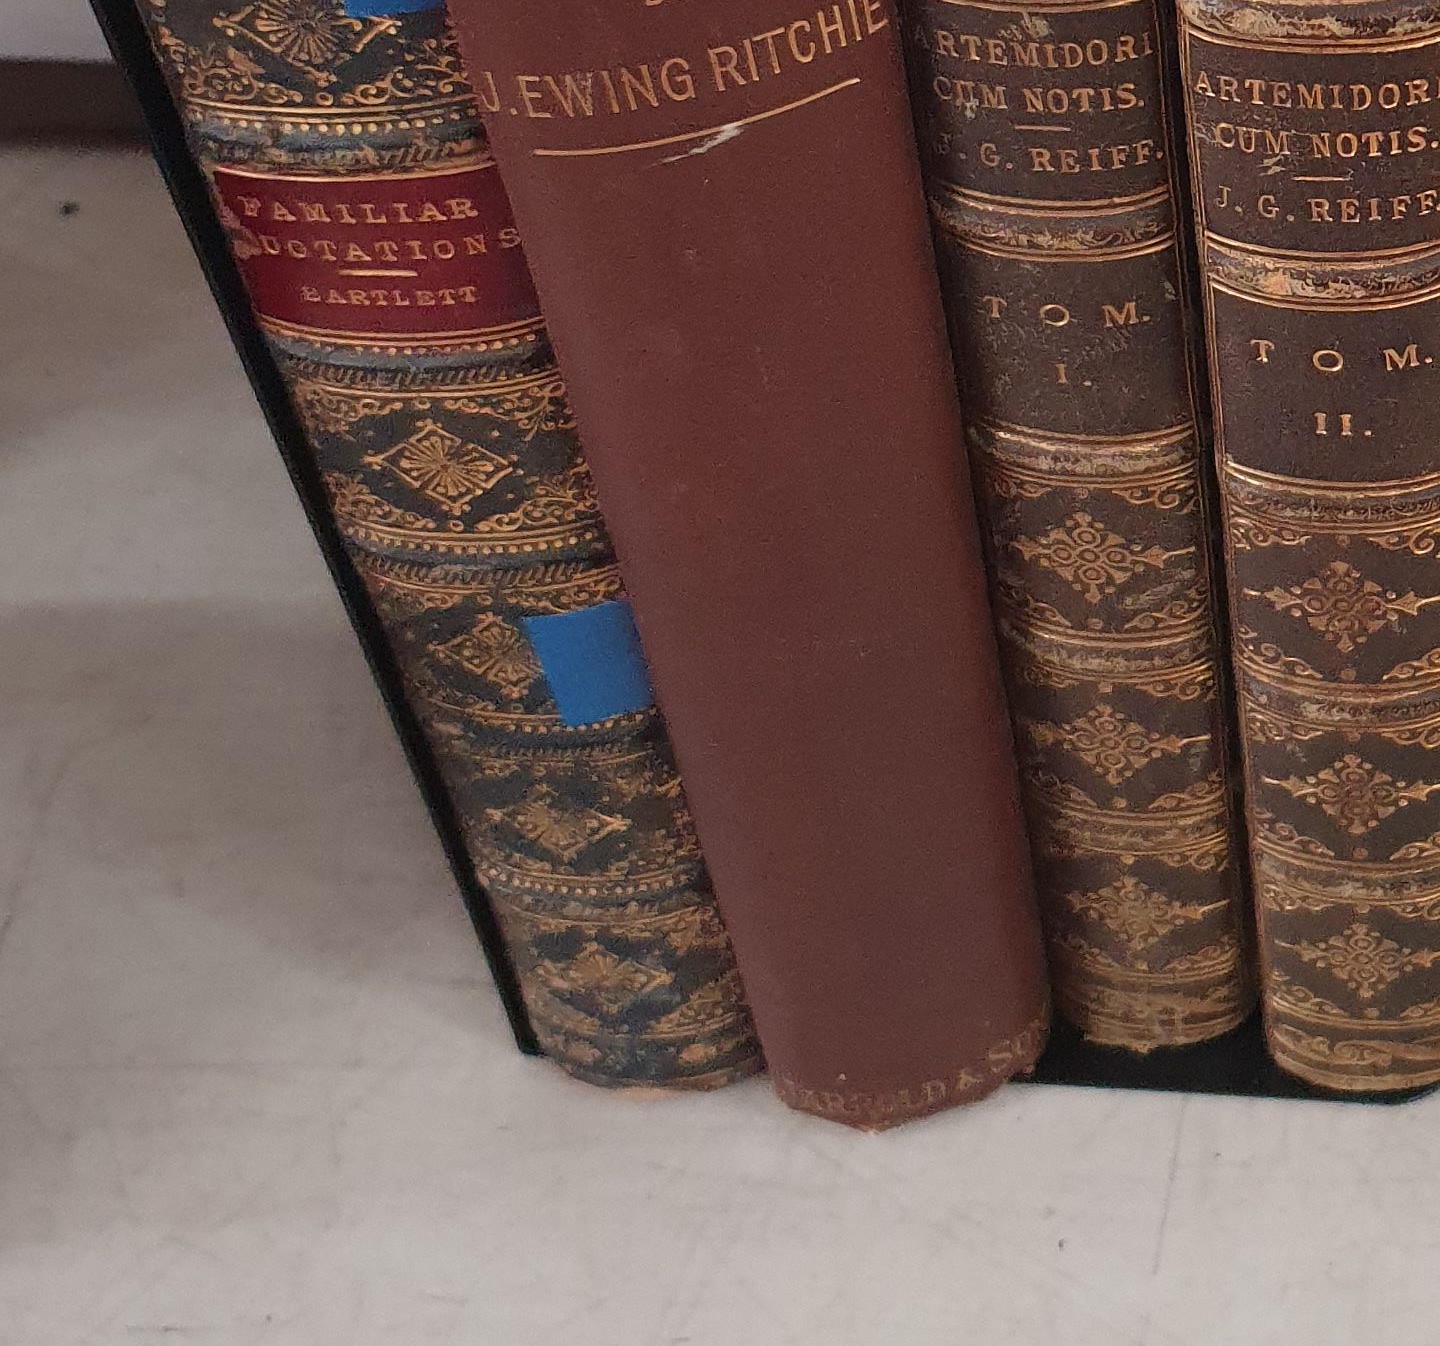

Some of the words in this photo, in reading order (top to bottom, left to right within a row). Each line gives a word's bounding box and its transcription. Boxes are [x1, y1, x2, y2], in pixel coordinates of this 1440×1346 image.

[1023, 82, 1146, 114] NOTIS.
[979, 142, 1014, 170] G.
[1029, 139, 1165, 175] REIFF.
[1214, 121, 1291, 155] CUM
[1309, 126, 1440, 159] NOTIS.
[237, 195, 479, 224] FAMILIAR
[1216, 185, 1243, 213] J.
[1257, 194, 1296, 223] G.
[246, 227, 522, 263] UOTATIONS
[300, 285, 482, 307] BARTLETT
